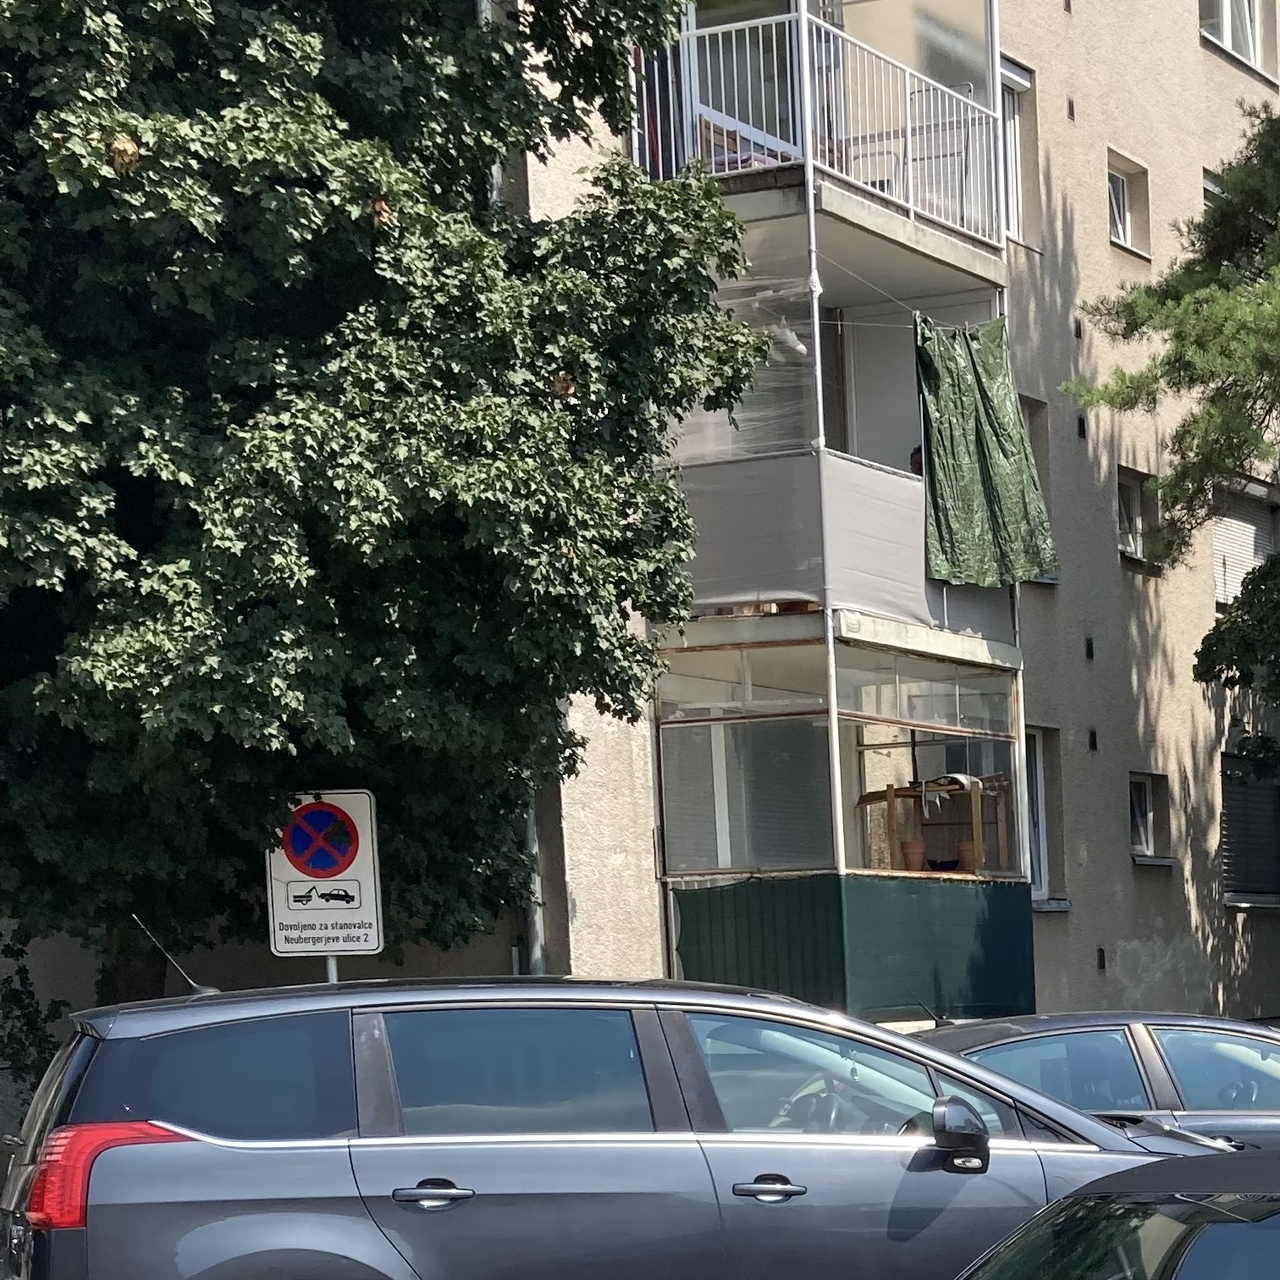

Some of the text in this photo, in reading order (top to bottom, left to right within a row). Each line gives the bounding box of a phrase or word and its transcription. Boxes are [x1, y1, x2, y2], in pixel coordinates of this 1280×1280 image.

[279, 921, 317, 933] Dovoljeno
[331, 920, 373, 930] stanovalce
[284, 933, 369, 945] Neubergerjeve ulice 2
